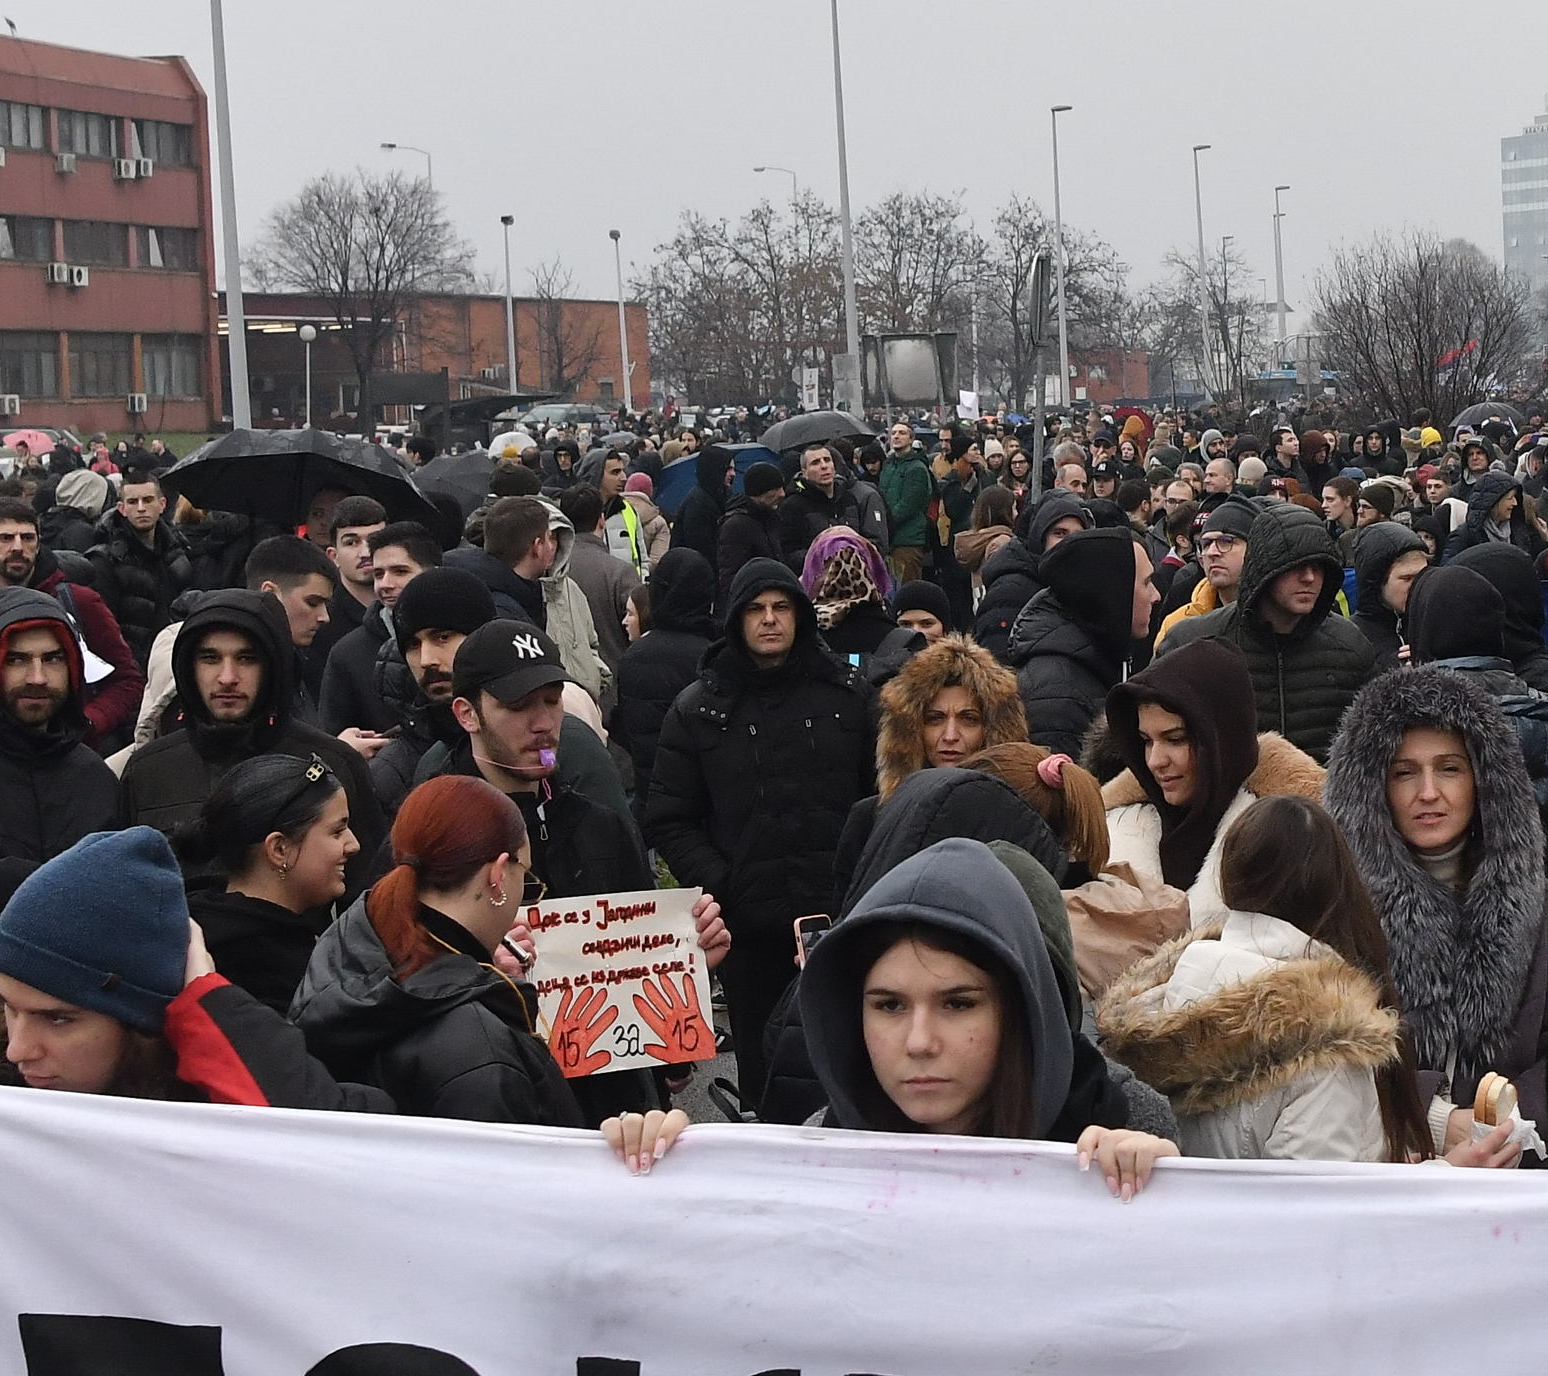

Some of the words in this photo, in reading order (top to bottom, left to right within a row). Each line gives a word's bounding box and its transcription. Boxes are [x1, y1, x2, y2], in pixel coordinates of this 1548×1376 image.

[512, 633, 544, 659] NY
[558, 1026, 580, 1068] 15
[672, 1014, 700, 1052] 15
